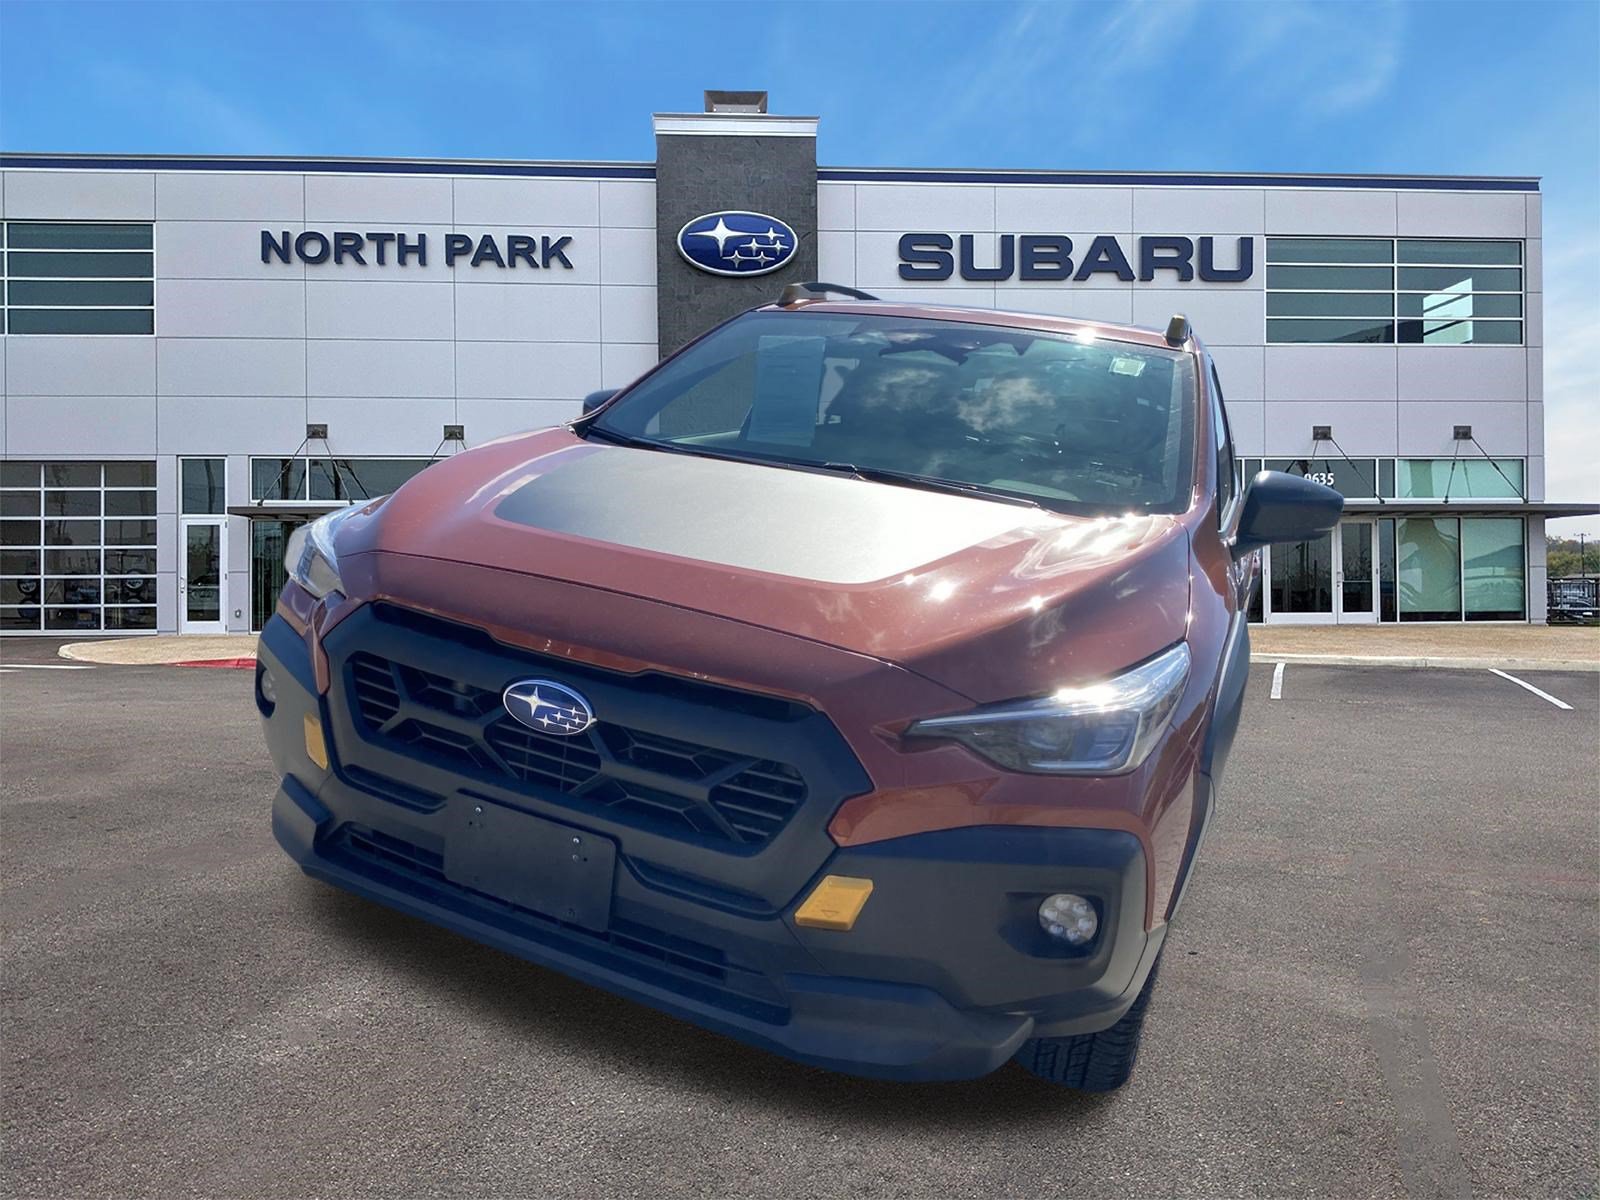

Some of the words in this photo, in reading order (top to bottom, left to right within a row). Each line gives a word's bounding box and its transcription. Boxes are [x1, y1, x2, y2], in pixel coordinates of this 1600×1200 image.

[261, 230, 427, 267] NORTH
[445, 233, 574, 269] PARK
[898, 233, 1254, 282] SUBARU
